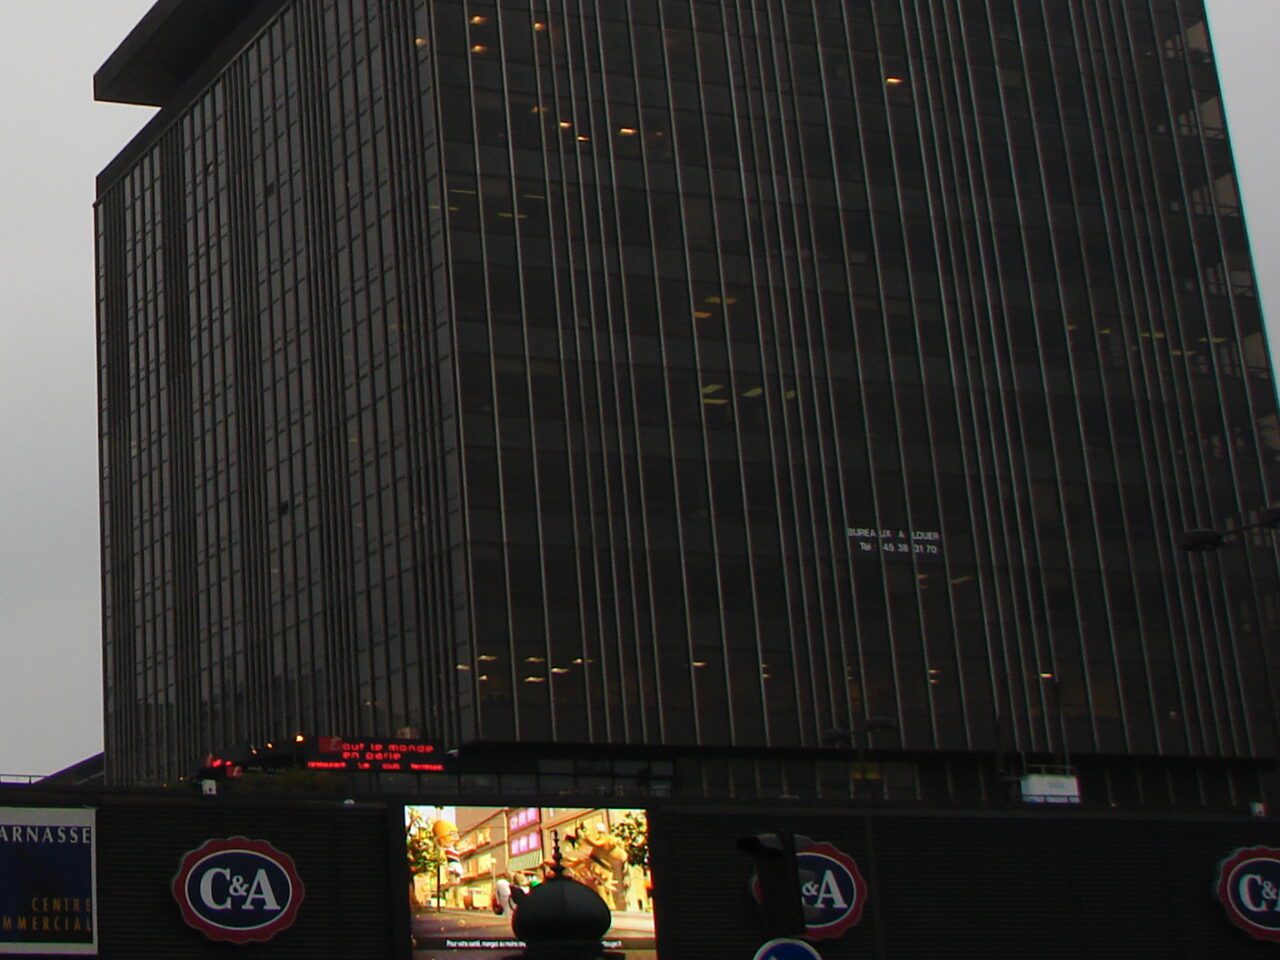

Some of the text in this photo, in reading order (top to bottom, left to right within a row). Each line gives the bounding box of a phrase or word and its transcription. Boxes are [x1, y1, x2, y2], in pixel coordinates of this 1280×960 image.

[898, 530, 905, 539] A
[31, 897, 91, 912] CENTRE
[200, 867, 281, 910] C&A
[801, 869, 849, 908] &A
[1239, 874, 1280, 912] C&
